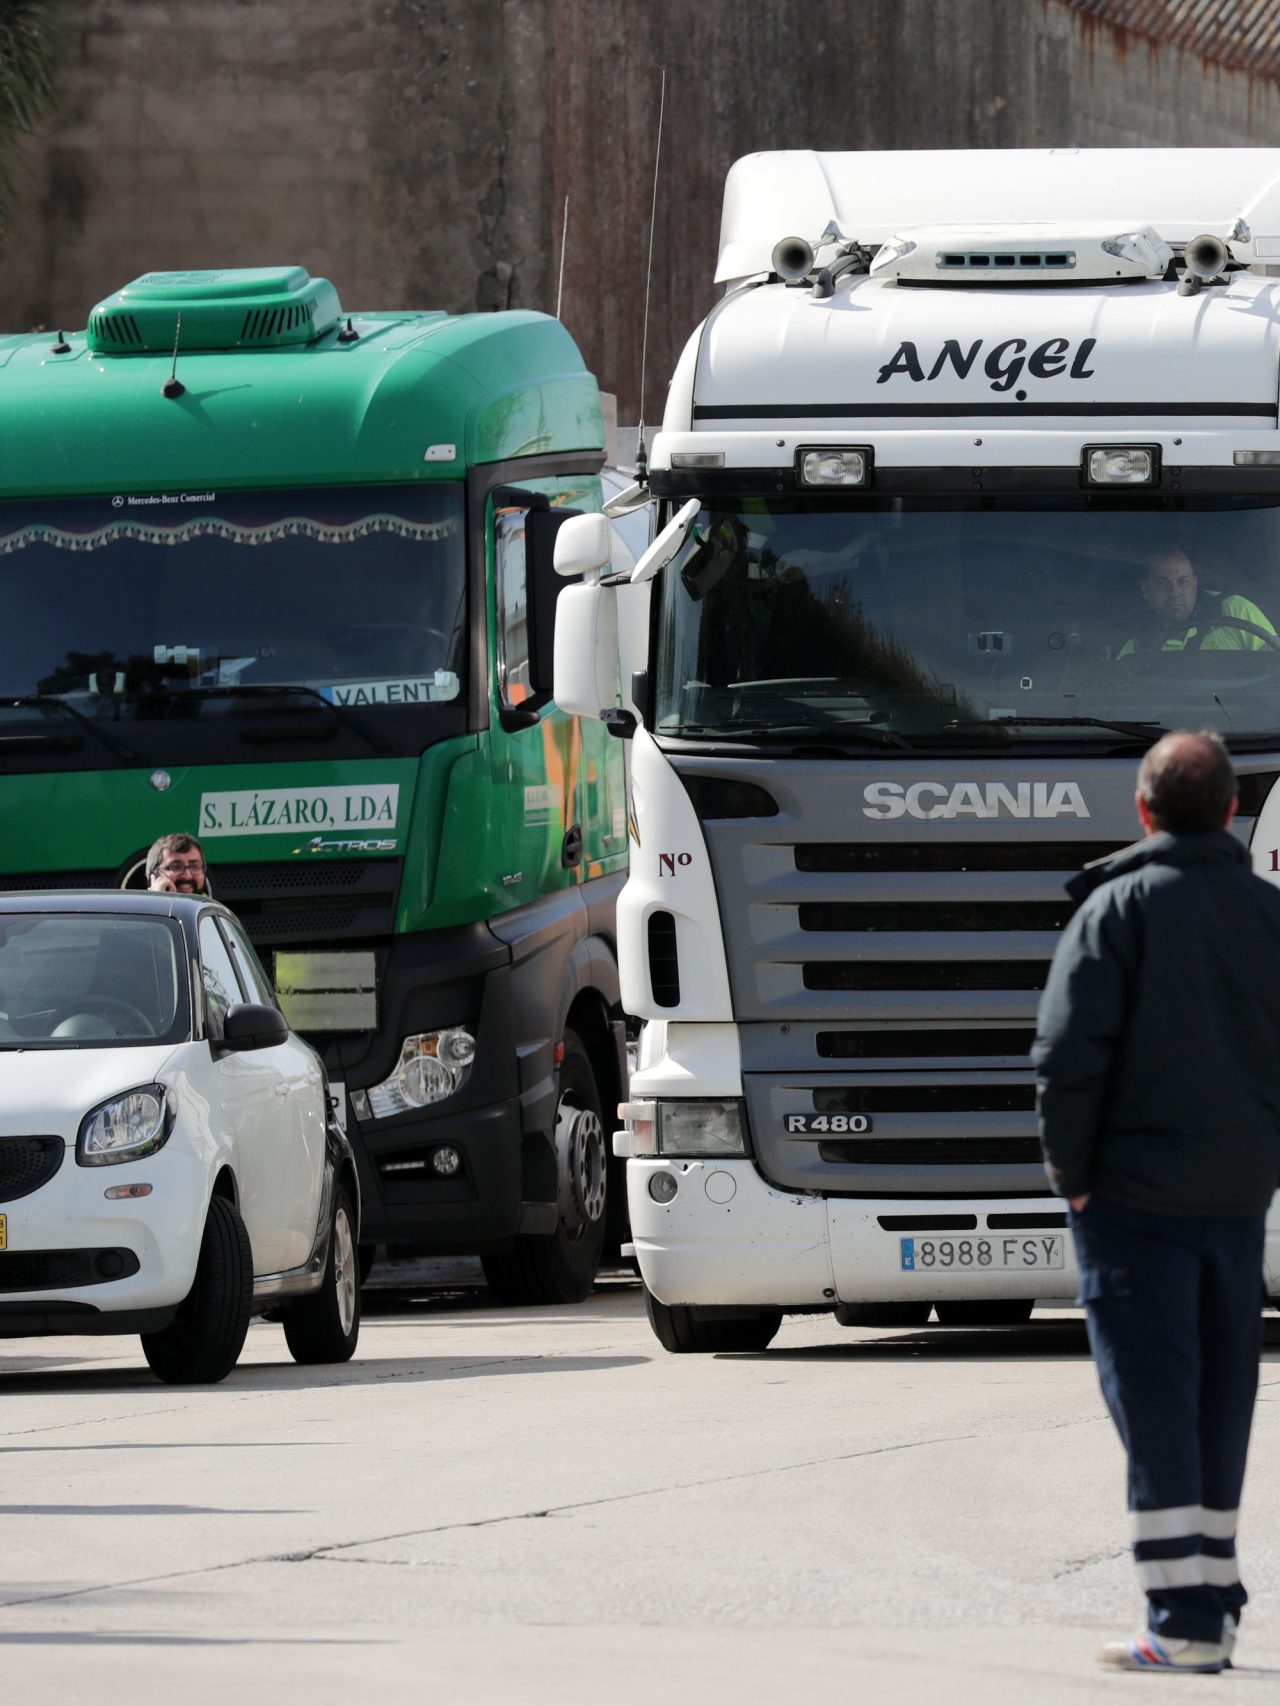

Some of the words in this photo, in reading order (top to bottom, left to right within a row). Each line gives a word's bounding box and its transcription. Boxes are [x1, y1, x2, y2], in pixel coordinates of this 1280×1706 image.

[127, 495, 179, 505] Mercedes-Benz
[180, 492, 216, 502] Comercial
[203, 803, 223, 829] S.
[230, 794, 335, 828] LÁZARO,
[344, 795, 393, 822] LDA
[862, 782, 1091, 820] SCANIA
[788, 1115, 807, 1132] R
[811, 1115, 868, 1132] 480
[921, 1241, 992, 1267] 8988
[1003, 1239, 1055, 1265] FSY
